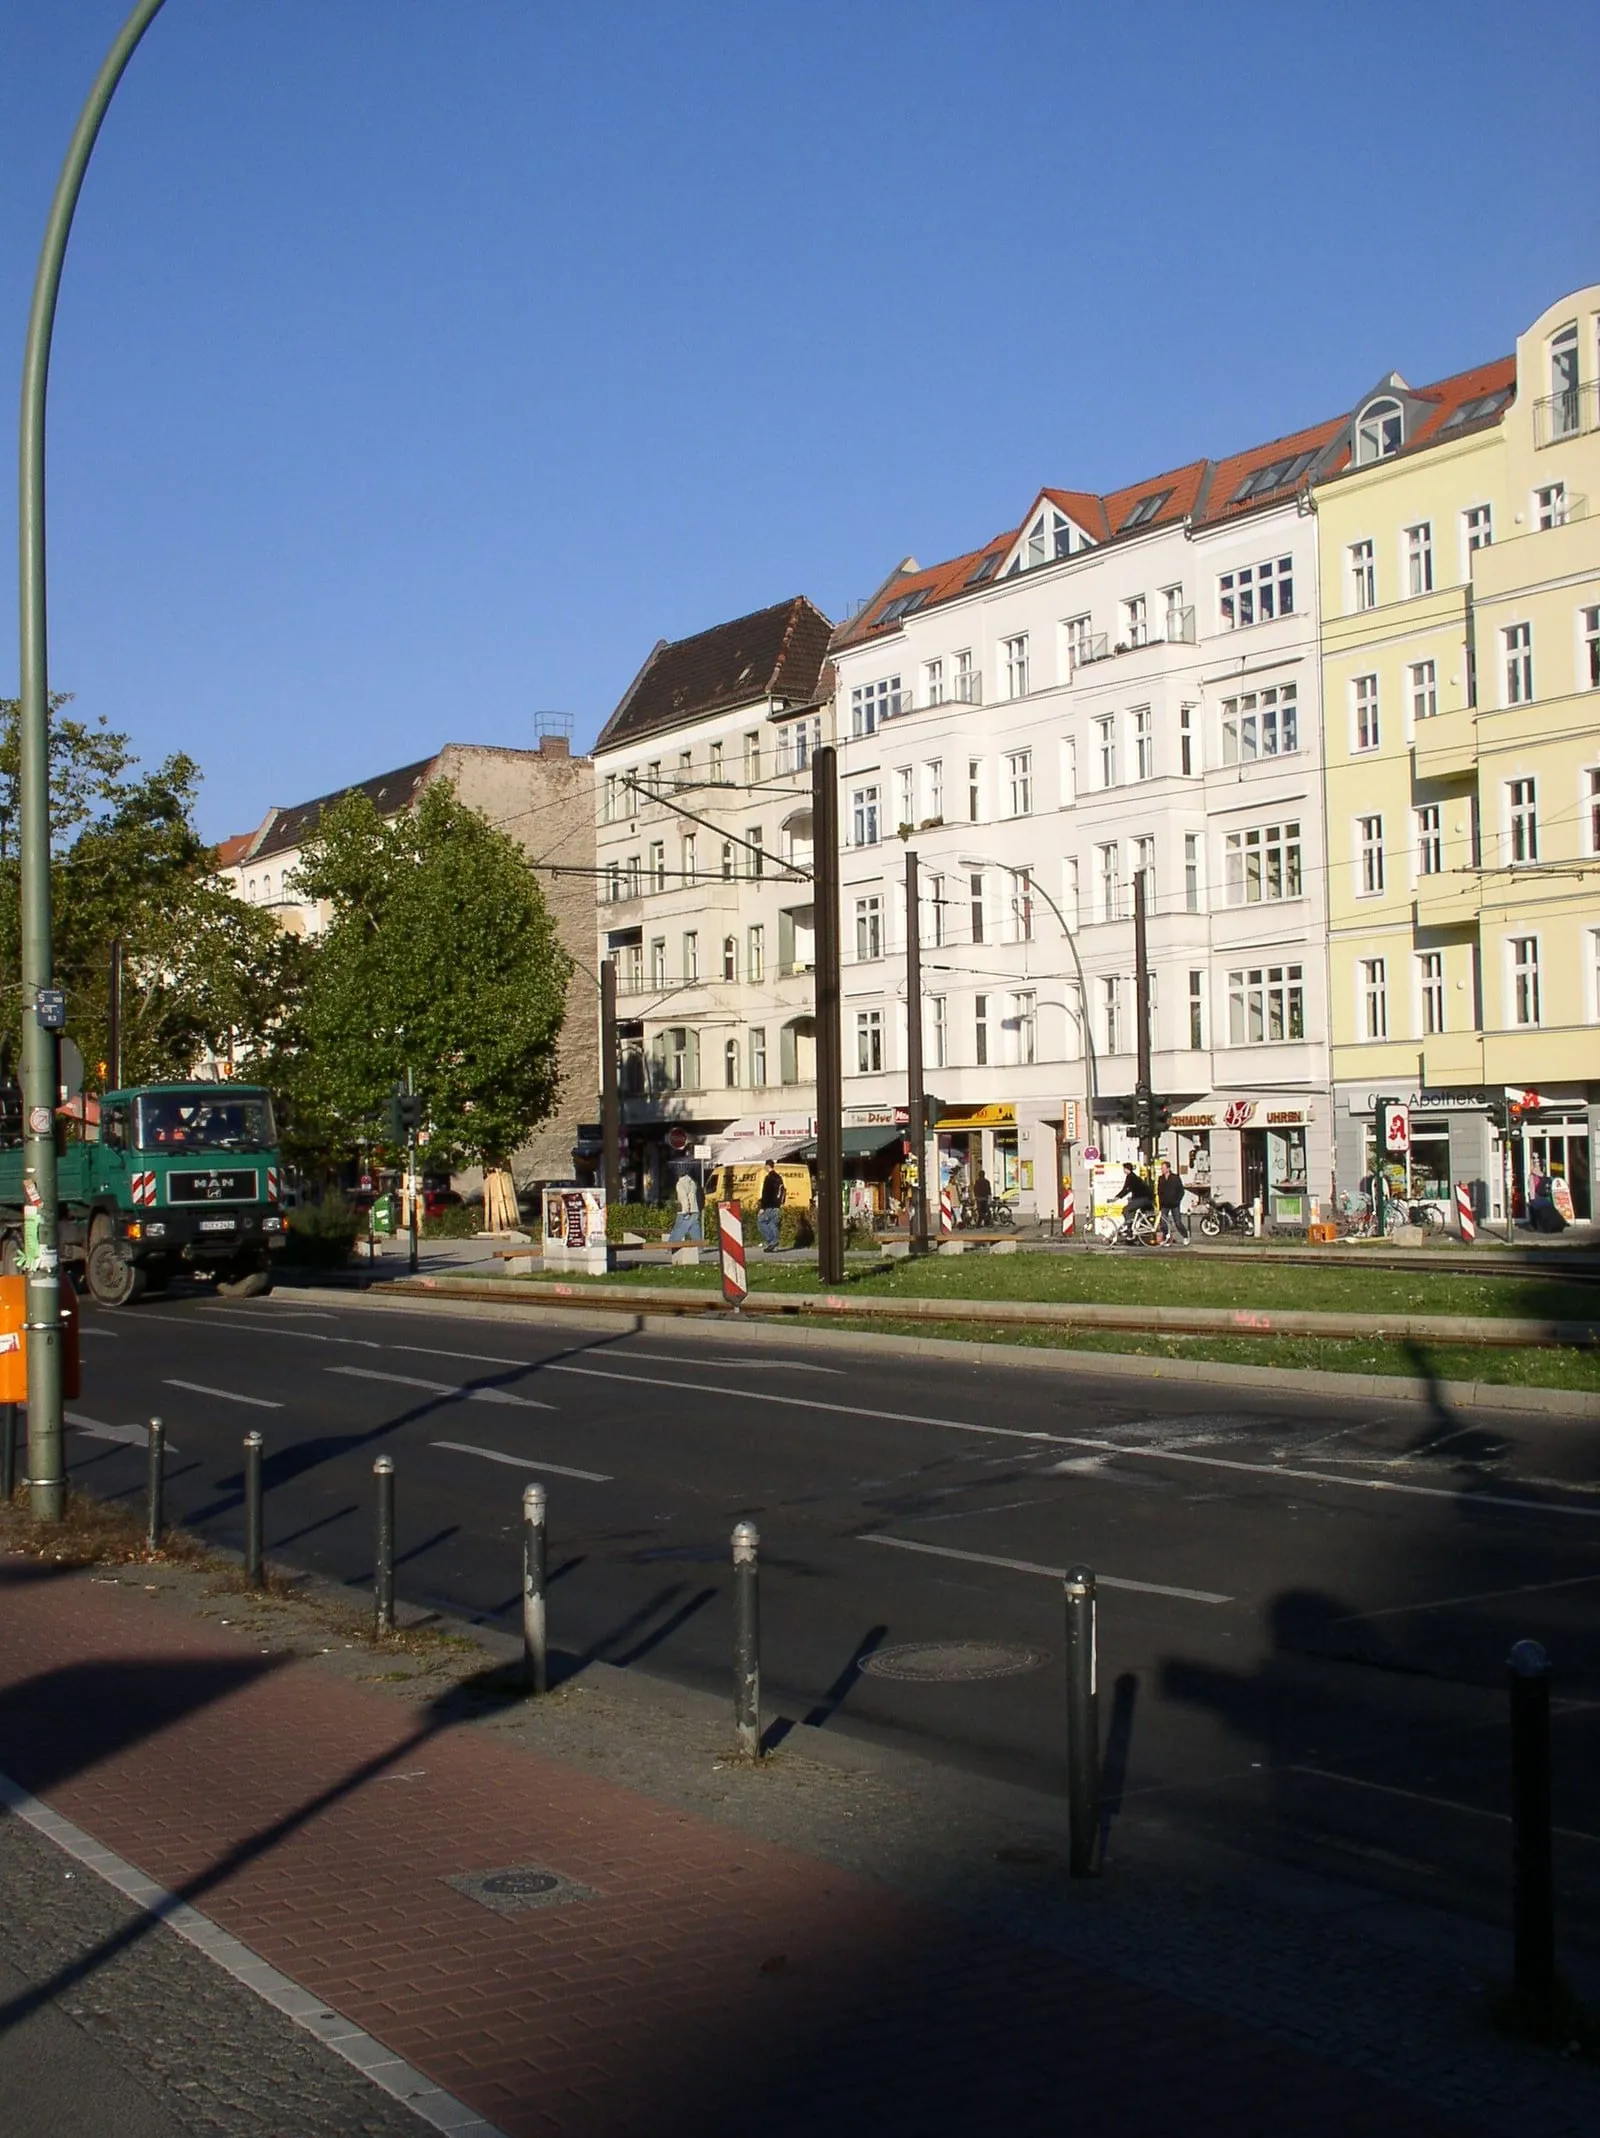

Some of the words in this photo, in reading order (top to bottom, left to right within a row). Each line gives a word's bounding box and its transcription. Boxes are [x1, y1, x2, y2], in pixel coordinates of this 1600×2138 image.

[1408, 1091, 1487, 1108] Apotheke
[1267, 1111, 1303, 1124] UHREN
[194, 1178, 235, 1189] MAN
